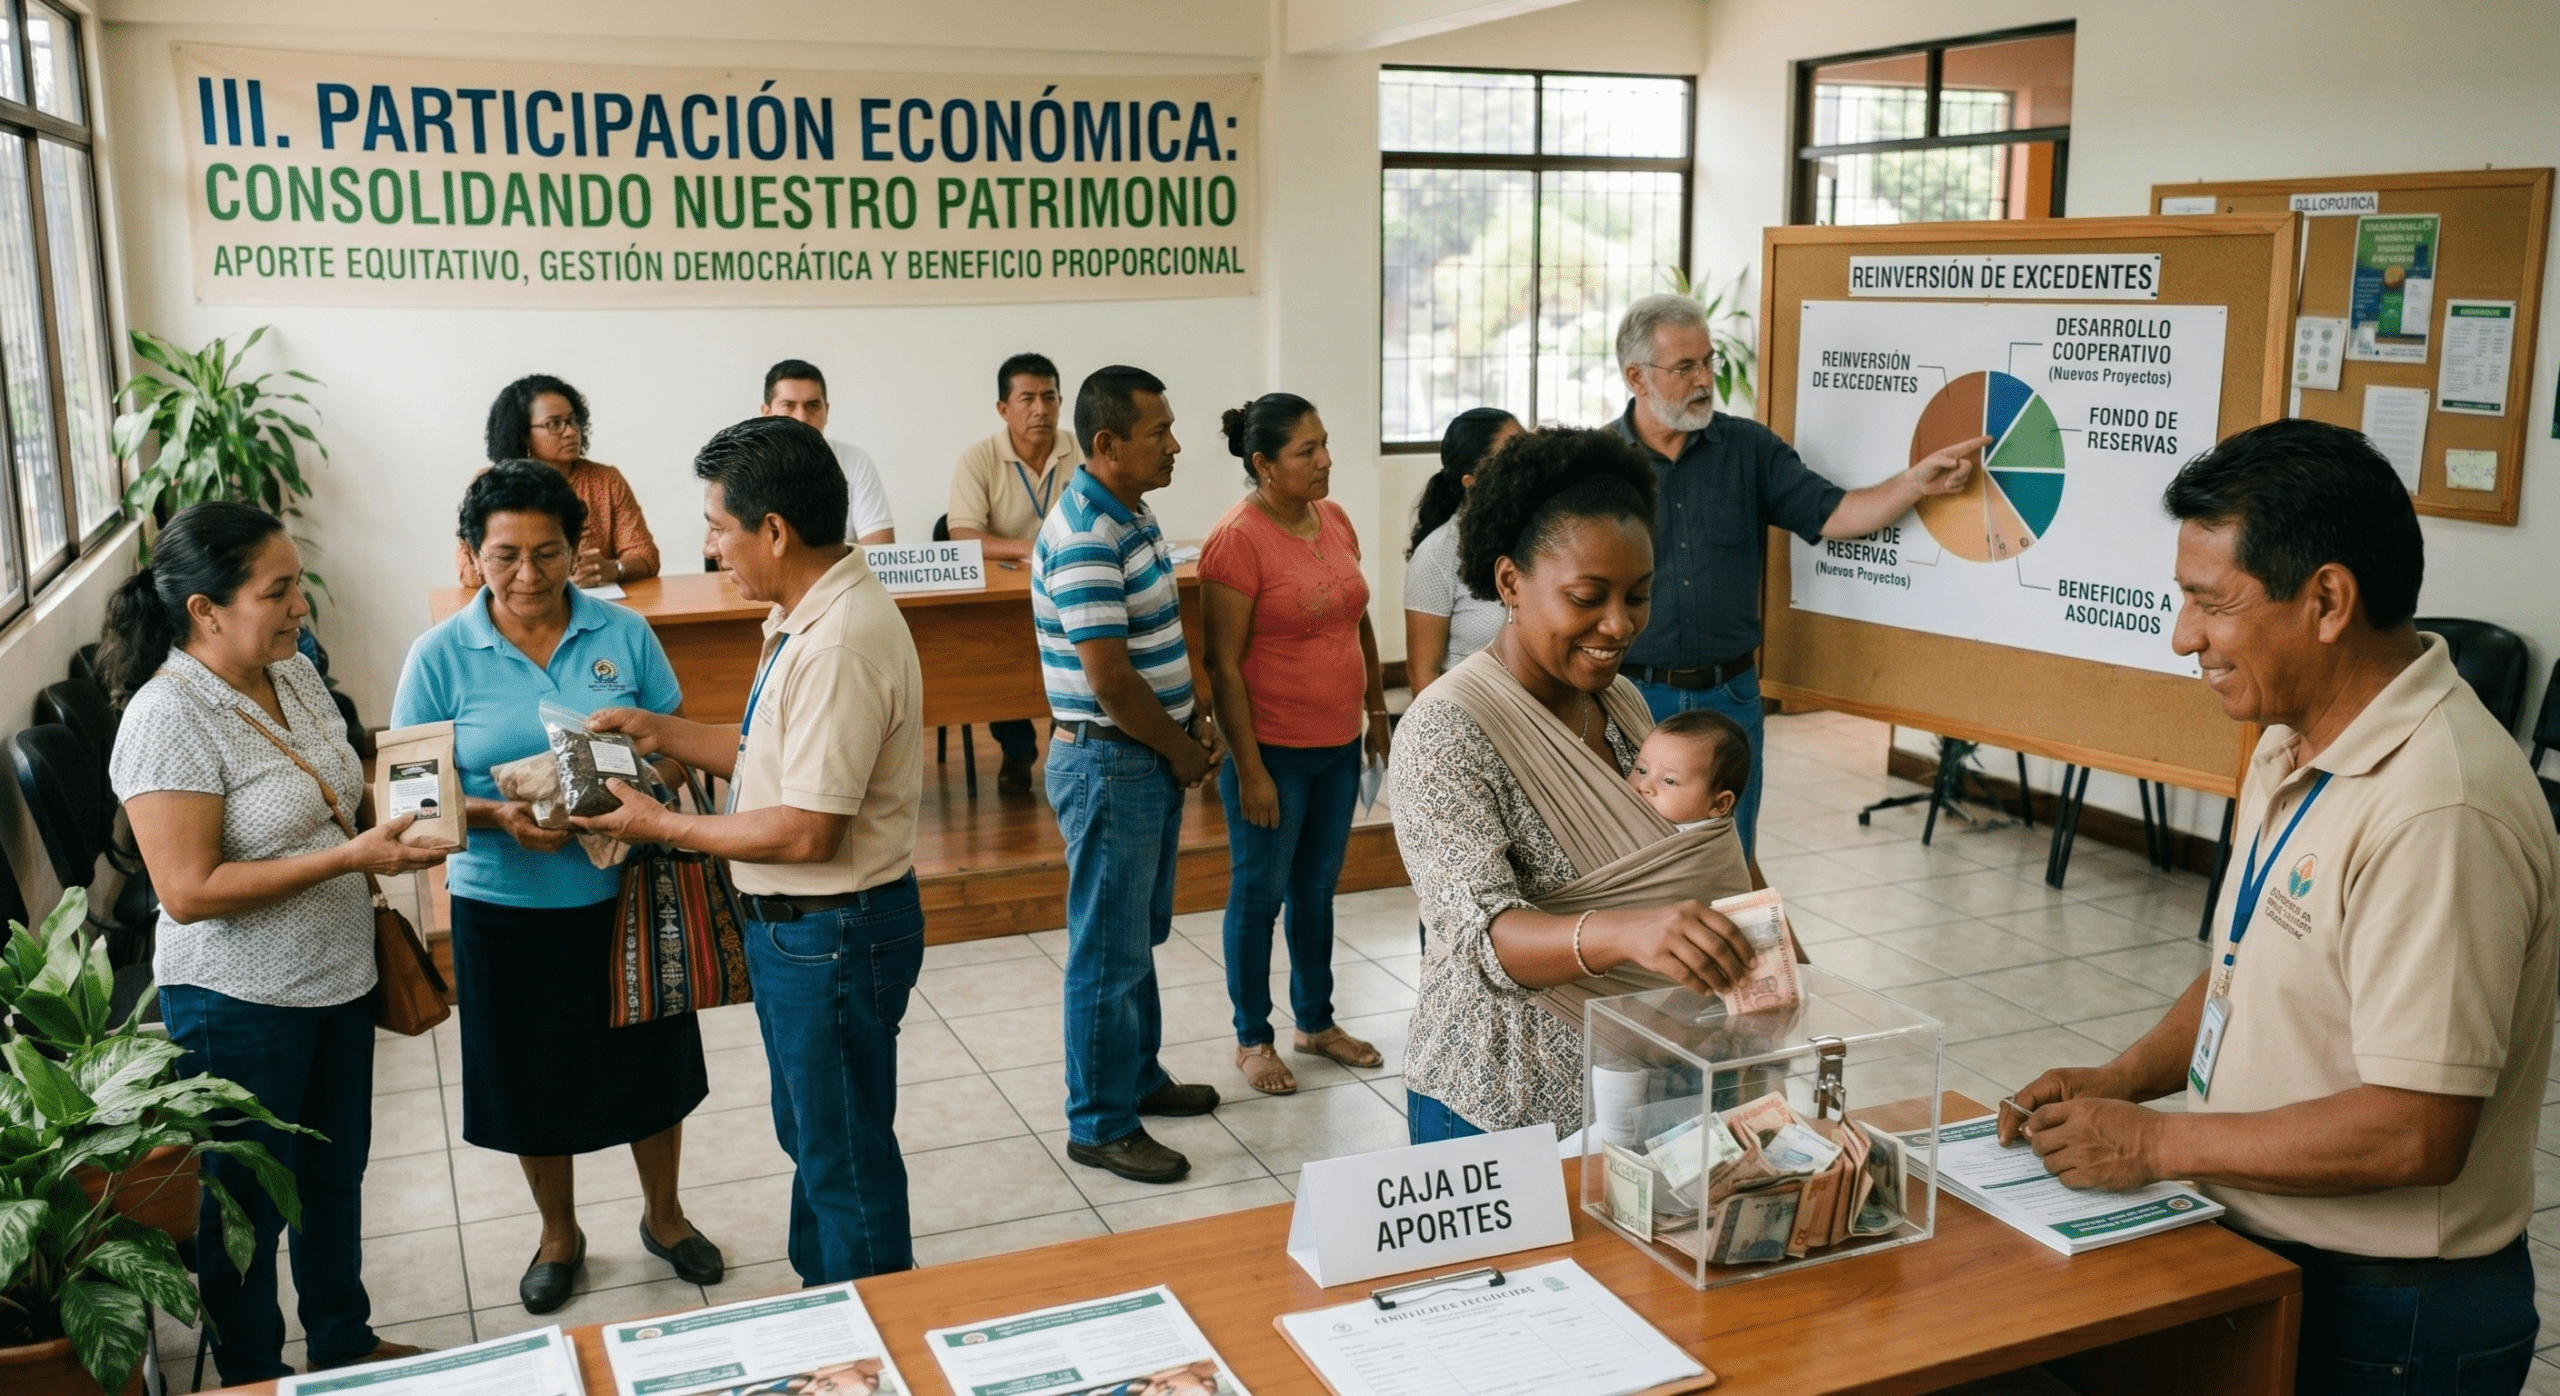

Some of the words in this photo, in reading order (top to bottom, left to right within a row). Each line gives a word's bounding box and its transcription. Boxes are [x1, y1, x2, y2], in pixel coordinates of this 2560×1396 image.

[198, 77, 289, 148] III.
[317, 80, 834, 161] PARTICIPACIÓN
[861, 85, 1236, 163] ECONÓMICA:
[206, 163, 651, 229] CONSOLIDANDO
[675, 176, 916, 229] NUESTRO
[938, 175, 1236, 228] PATRIMONIO
[214, 246, 334, 277] APORTE
[347, 248, 528, 285] EQUITATIVO,
[541, 243, 662, 281] GESTIÓN
[675, 243, 872, 280] DEMOCRÁTICA
[881, 251, 897, 279] Y
[909, 249, 1041, 279] BENEFICIO
[1053, 246, 1244, 277] PROPORCIONAL
[1852, 260, 1974, 289] REINVERSIÓN
[1981, 266, 2005, 288] DE
[2013, 264, 2152, 289] EXCEDENTES
[2057, 318, 2170, 339] DESARROLLO
[1822, 350, 1911, 370] REINVERSIÓN
[2053, 342, 2170, 364] COOPERATIVO
[1813, 372, 1829, 387] DE
[1833, 373, 1917, 393] EXCEDENTES
[2049, 366, 2098, 382] (Nuevos
[2103, 369, 2171, 388] Proyectos)
[2090, 407, 2148, 428] FONDO
[2156, 411, 2177, 429] DE
[2087, 432, 2178, 455] RESERVAS
[1883, 527, 1900, 545] DE
[868, 549, 935, 566] CONSEJO
[941, 548, 958, 561] DE
[1827, 540, 1897, 566] RESERVAS
[1816, 561, 1853, 578] (Nuevos
[1857, 566, 1911, 590] Proyectos)
[2059, 580, 2155, 610] BENEFICIOS
[2161, 594, 2171, 612] A
[2065, 604, 2161, 635] ASOCIADOS
[1377, 1170, 1456, 1208] CAJA
[1463, 1160, 1501, 1194] DE
[1377, 1199, 1512, 1252] APORTES
